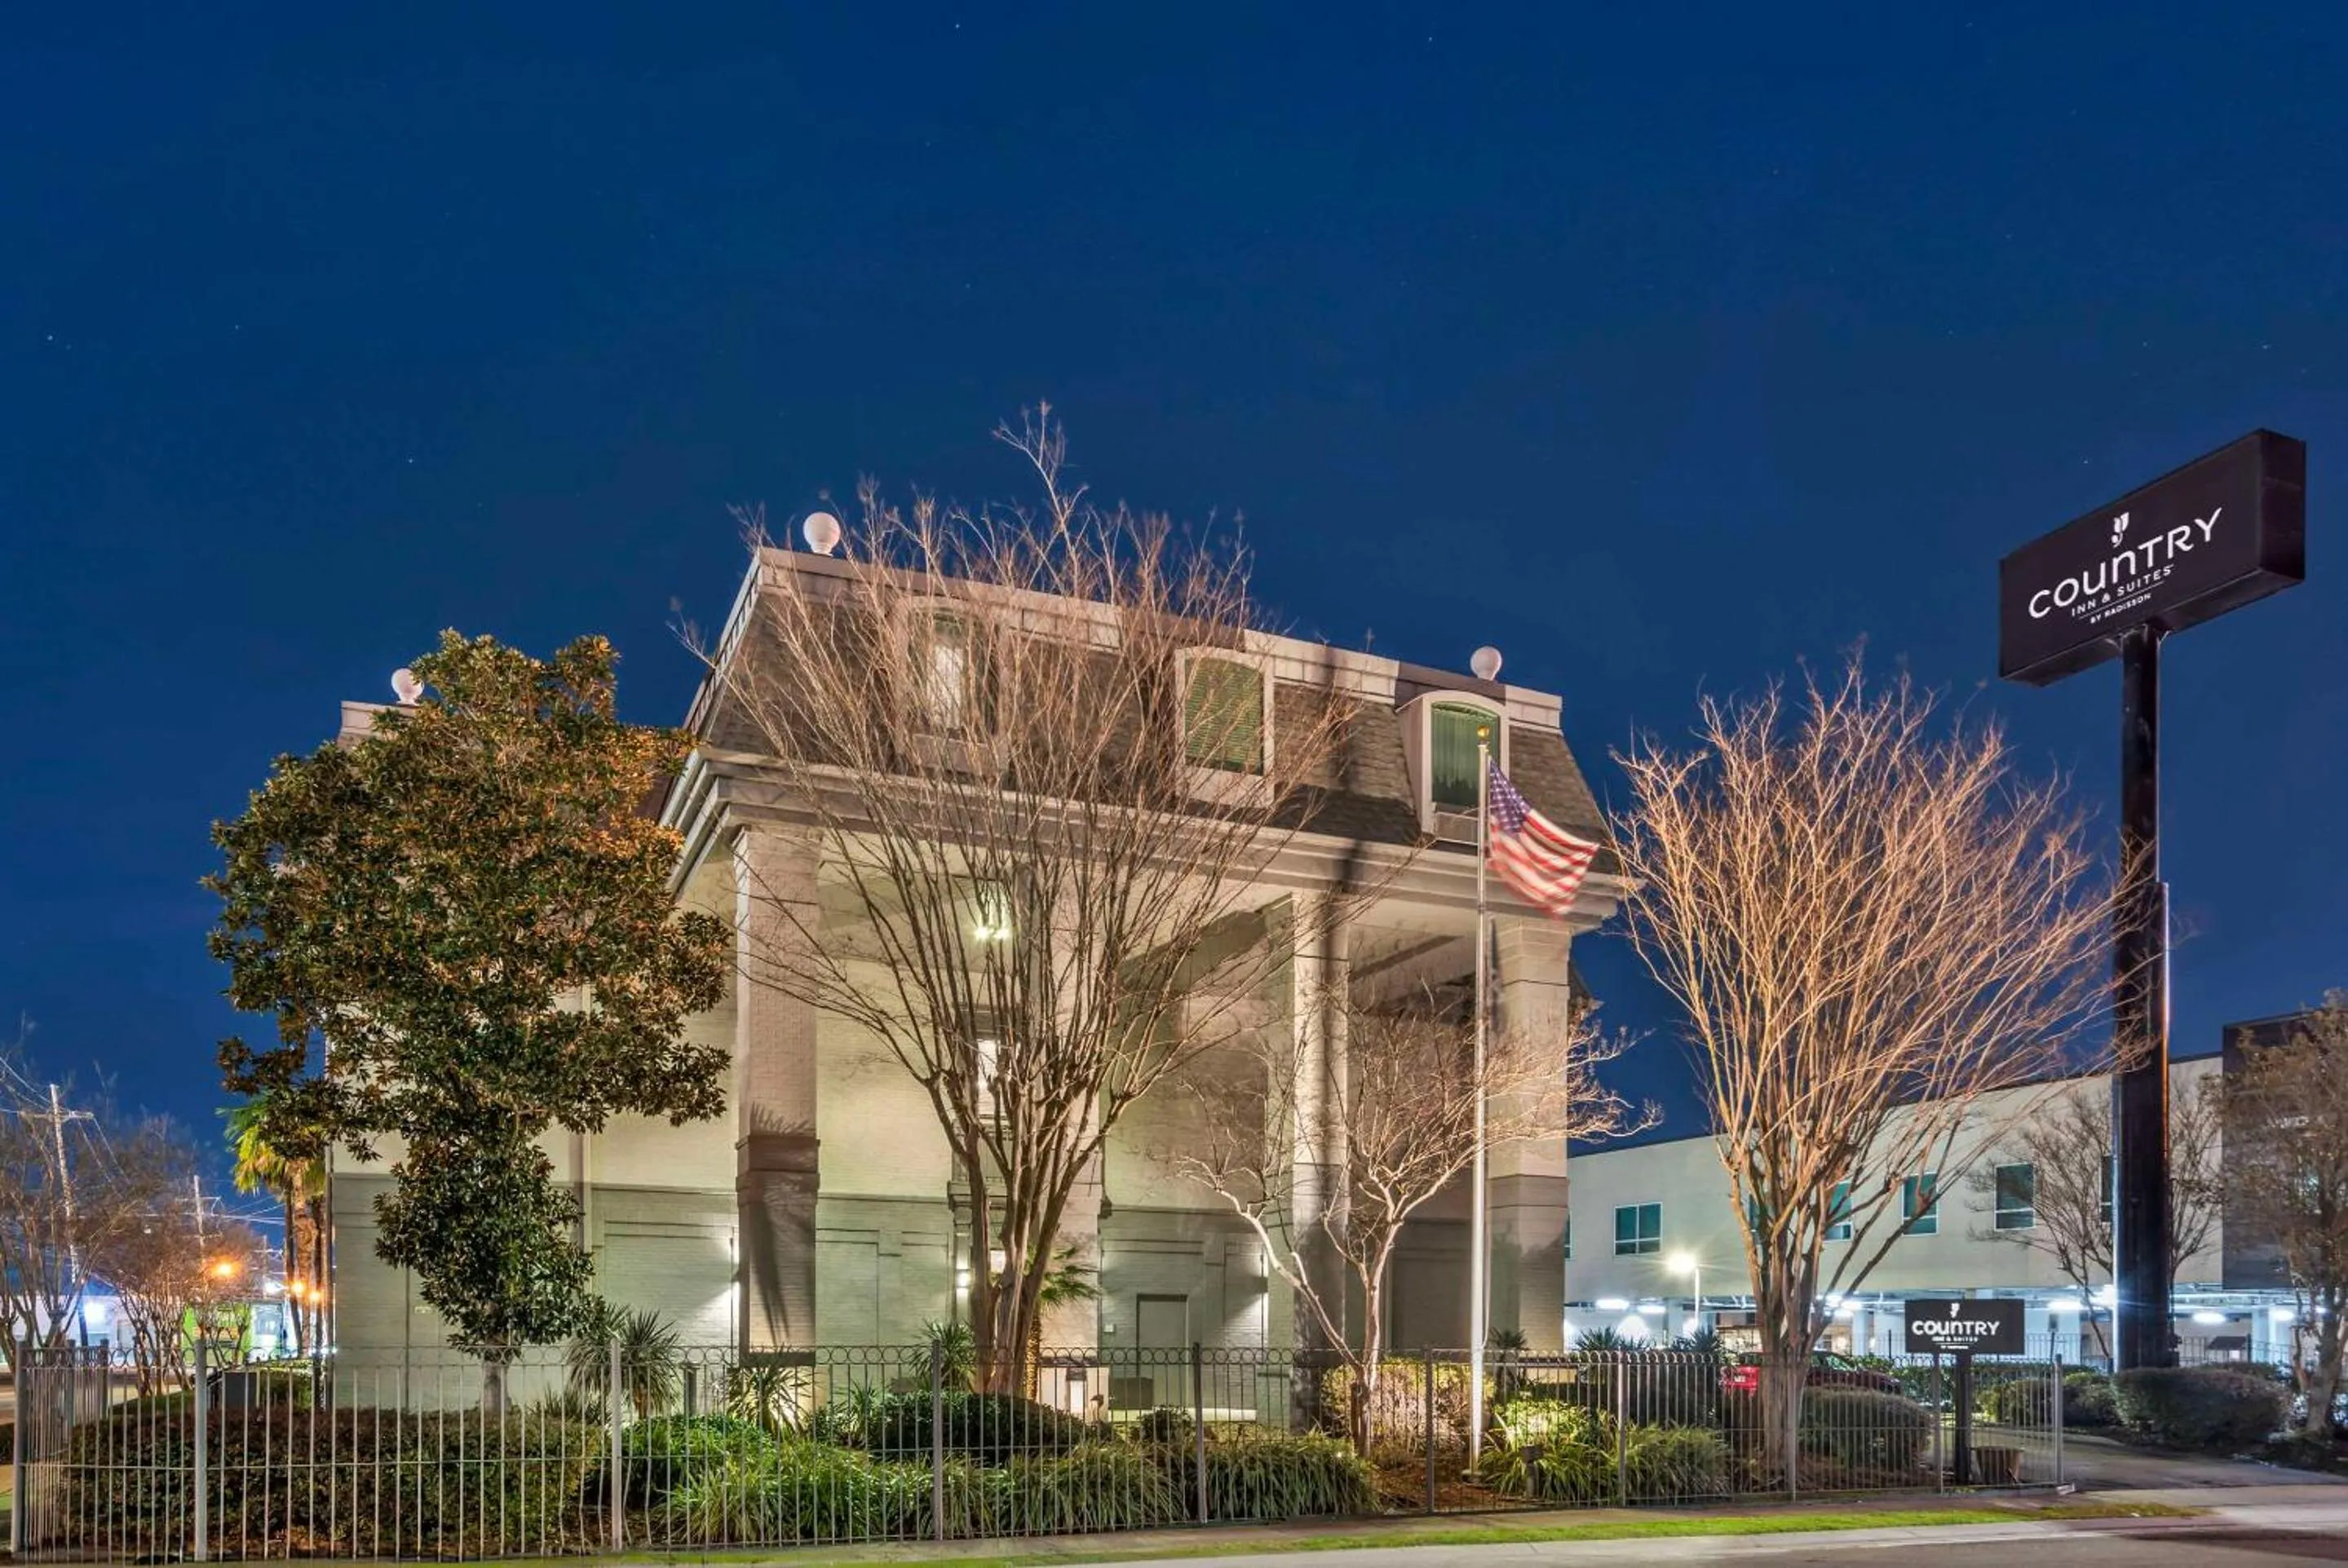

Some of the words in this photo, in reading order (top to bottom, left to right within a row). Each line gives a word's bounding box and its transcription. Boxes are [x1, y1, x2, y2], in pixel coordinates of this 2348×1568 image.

[2072, 598, 2096, 616] INN
[2101, 593, 2111, 603] &
[2116, 563, 2174, 597] SUITES
[2090, 614, 2102, 624] BY
[2104, 593, 2151, 617] RADISSON
